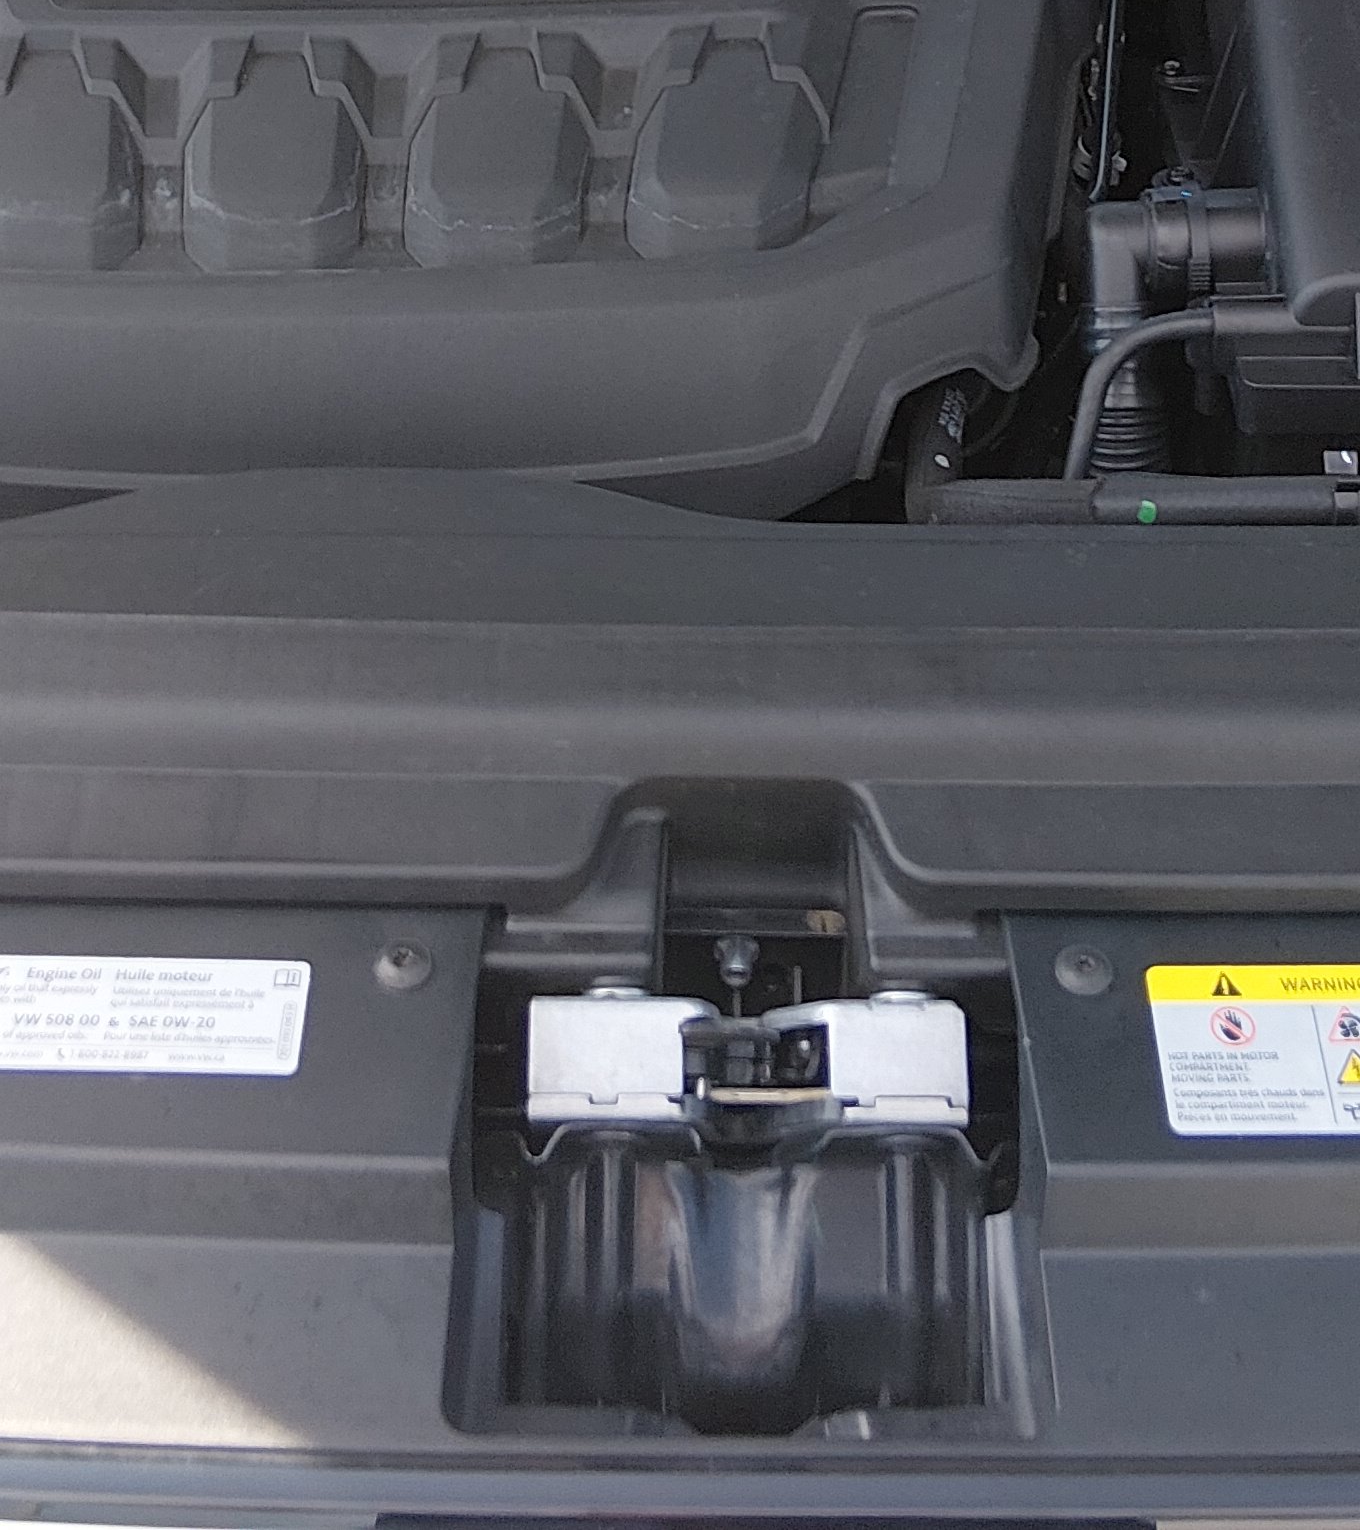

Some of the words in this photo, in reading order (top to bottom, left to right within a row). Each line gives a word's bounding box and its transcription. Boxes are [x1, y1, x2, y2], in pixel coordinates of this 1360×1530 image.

[26, 967, 77, 982] Engine
[80, 968, 102, 980] Oil
[115, 968, 155, 981] Huile
[158, 970, 214, 982] moteur
[28, 983, 49, 992] that
[51, 984, 99, 996] expressly
[153, 987, 216, 998] uniquement
[219, 987, 232, 997] de
[13, 995, 36, 1004] with
[14, 1013, 42, 1026] VW
[46, 1013, 75, 1026] 508
[79, 1014, 100, 1026] 00
[107, 1016, 120, 1027] &
[128, 1015, 159, 1028] SAE
[15, 1029, 66, 1041] approved
[104, 1030, 127, 1041] Pour
[1168, 1051, 1189, 1060] HOT
[1191, 1051, 1225, 1061] PARTS
[1226, 1051, 1238, 1060] IN
[1240, 1051, 1280, 1061] MOTOR
[1171, 1073, 1214, 1082] MOVING
[1173, 1088, 1237, 1099] Composants
[1261, 1088, 1298, 1098] chauds
[1299, 1088, 1325, 1098] dans
[1188, 1099, 1265, 1111] compartiment
